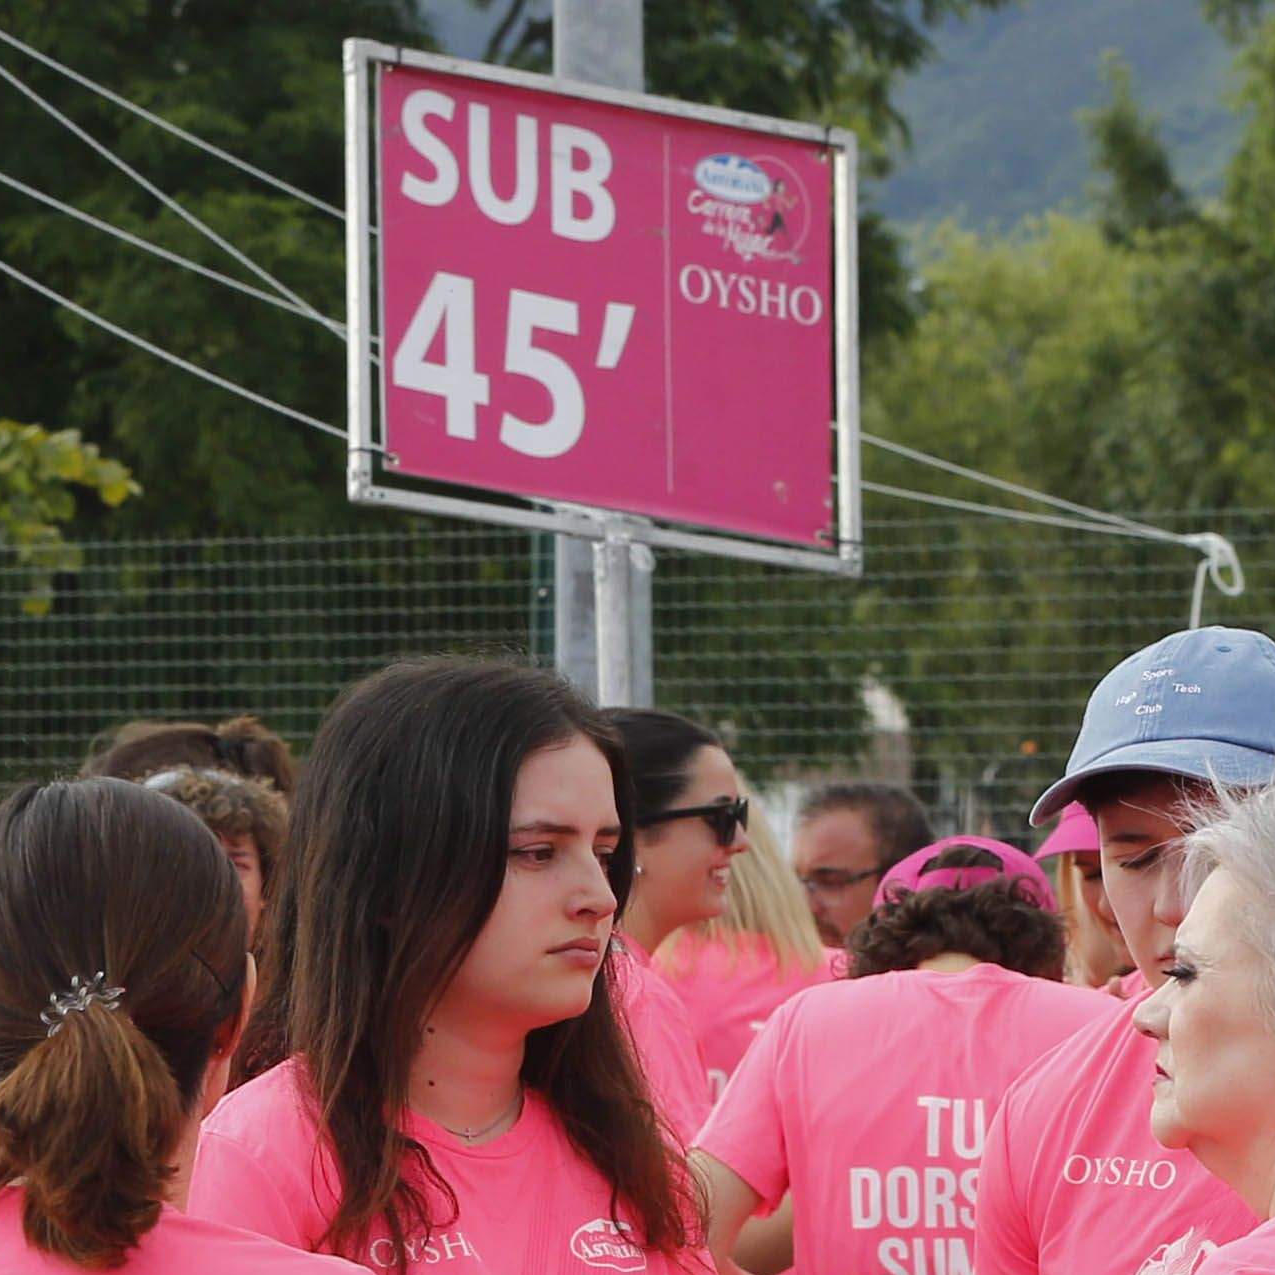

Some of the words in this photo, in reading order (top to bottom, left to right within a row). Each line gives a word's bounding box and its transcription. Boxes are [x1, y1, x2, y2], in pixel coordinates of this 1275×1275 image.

[400, 89, 616, 242] SUB
[678, 263, 824, 326] OYSHO
[392, 271, 636, 459] 45'
[1142, 668, 1174, 681] Sport
[1172, 683, 1202, 694] Tech
[1135, 703, 1163, 716] Club
[917, 1095, 986, 1159] TU
[1062, 1153, 1178, 1190] OYSHO
[369, 1231, 482, 1268] OYSH
